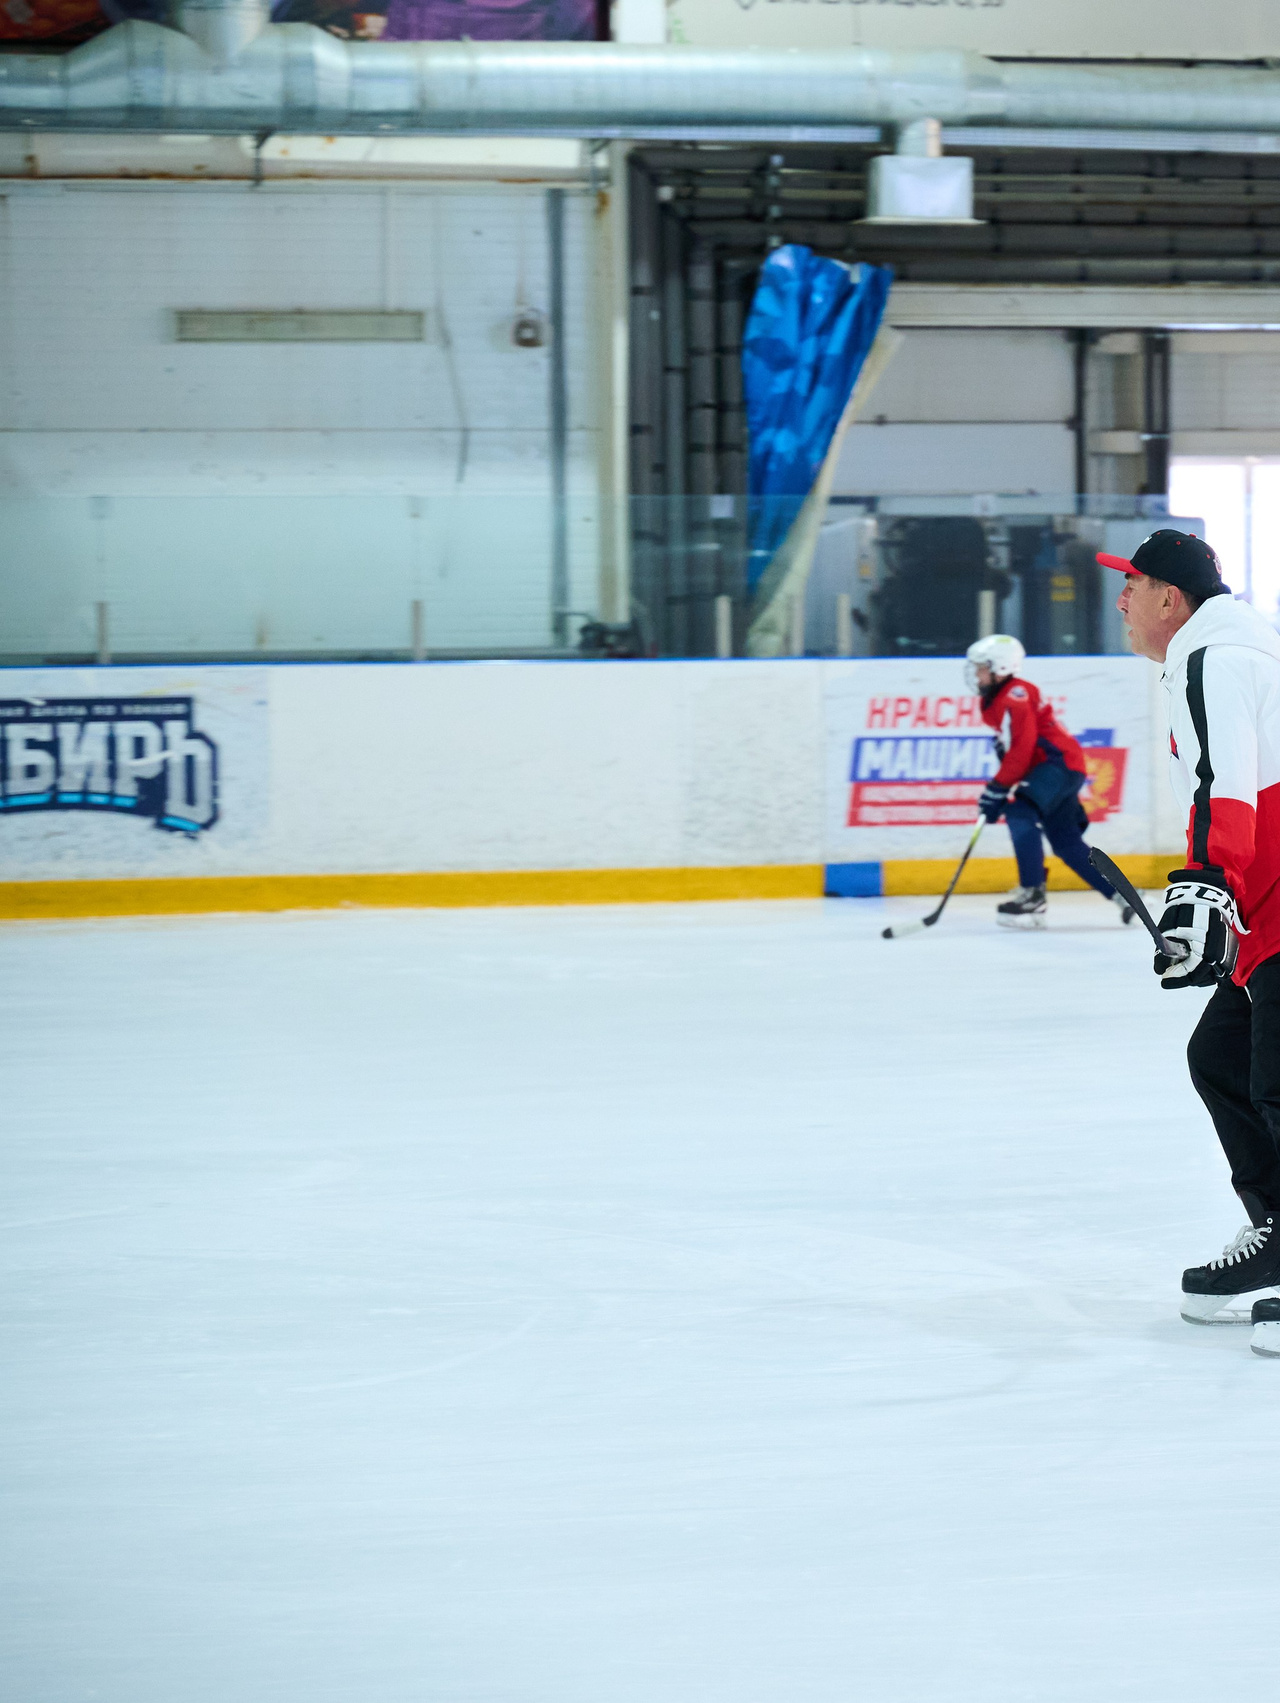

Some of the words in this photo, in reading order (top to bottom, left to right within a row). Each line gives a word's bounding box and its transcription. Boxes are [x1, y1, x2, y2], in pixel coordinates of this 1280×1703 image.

[0, 719, 214, 826] БИРЬ
[857, 738, 998, 780] МАШИН
[1165, 885, 1235, 920] CCM
